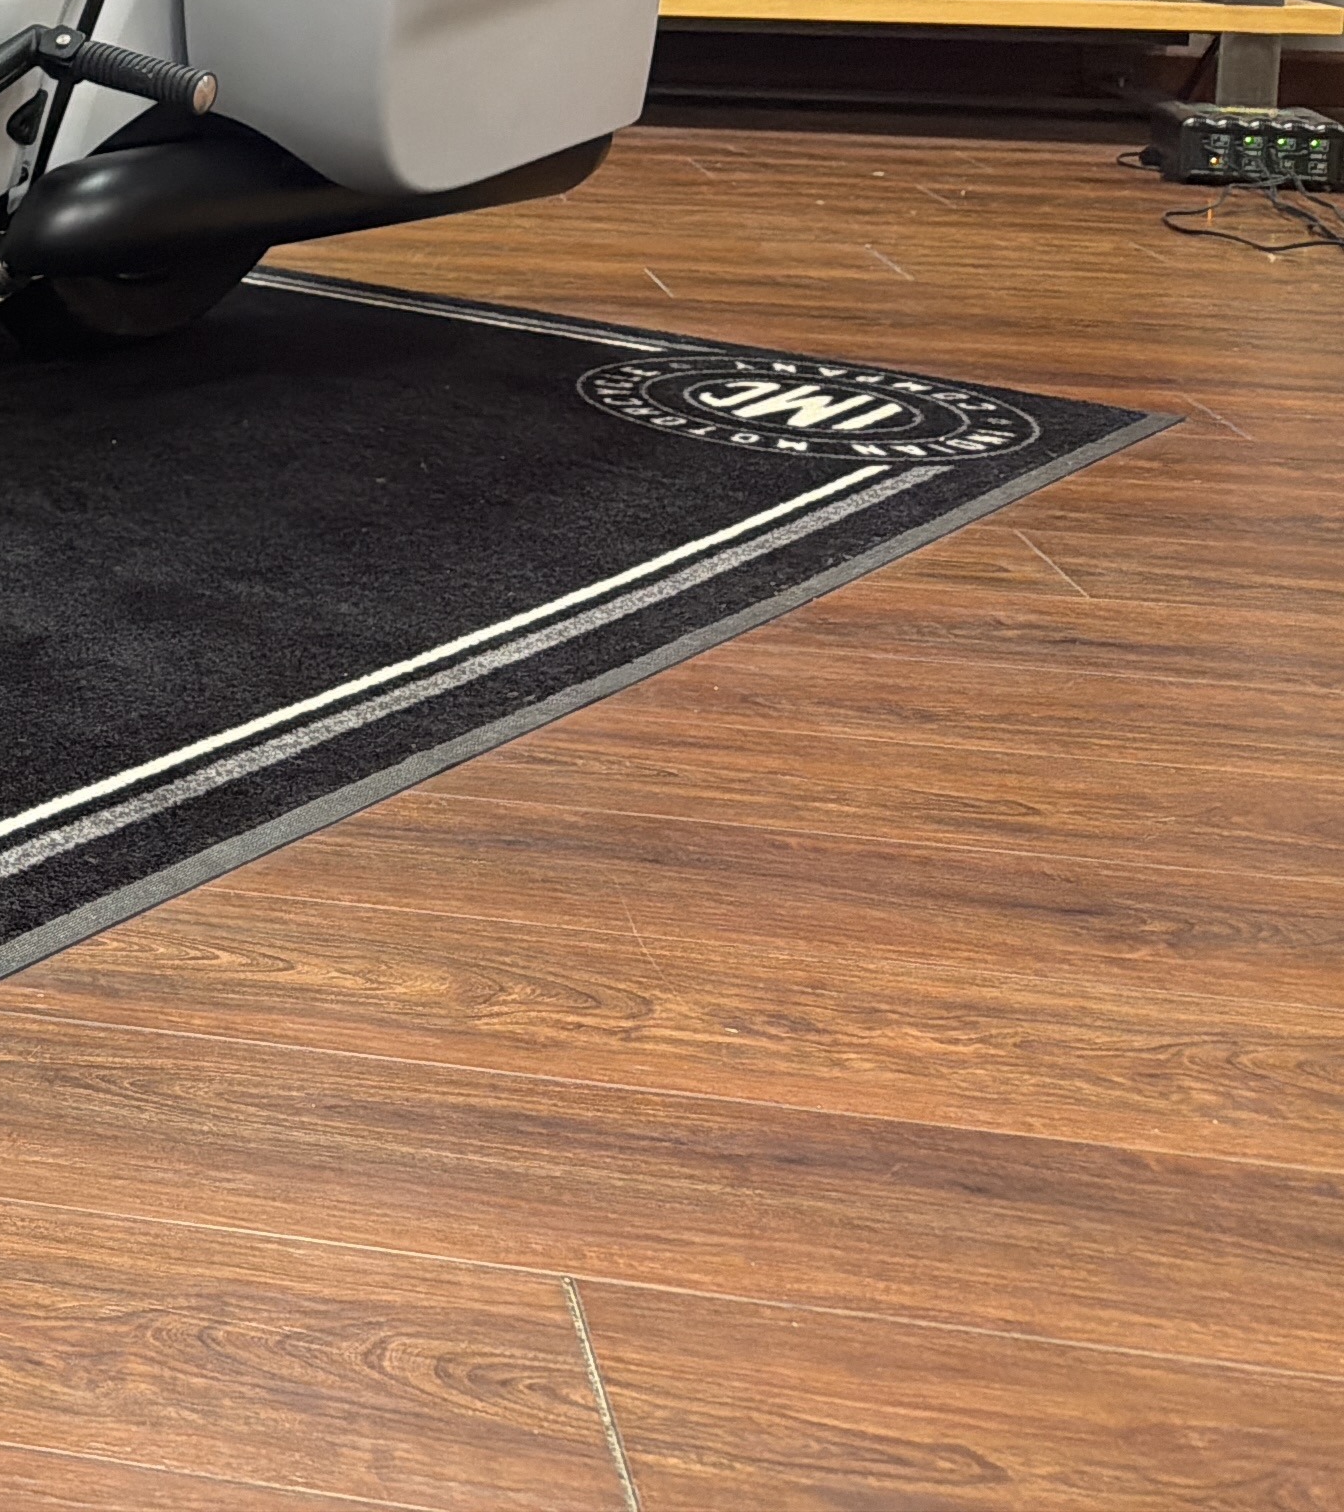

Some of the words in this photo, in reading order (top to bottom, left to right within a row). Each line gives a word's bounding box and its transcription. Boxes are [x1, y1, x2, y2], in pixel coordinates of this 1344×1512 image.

[593, 365, 809, 452] MOTORCYCLE
[699, 381, 903, 431] IMC
[734, 360, 998, 412] COMPANY
[853, 429, 1017, 456] INDIAN
